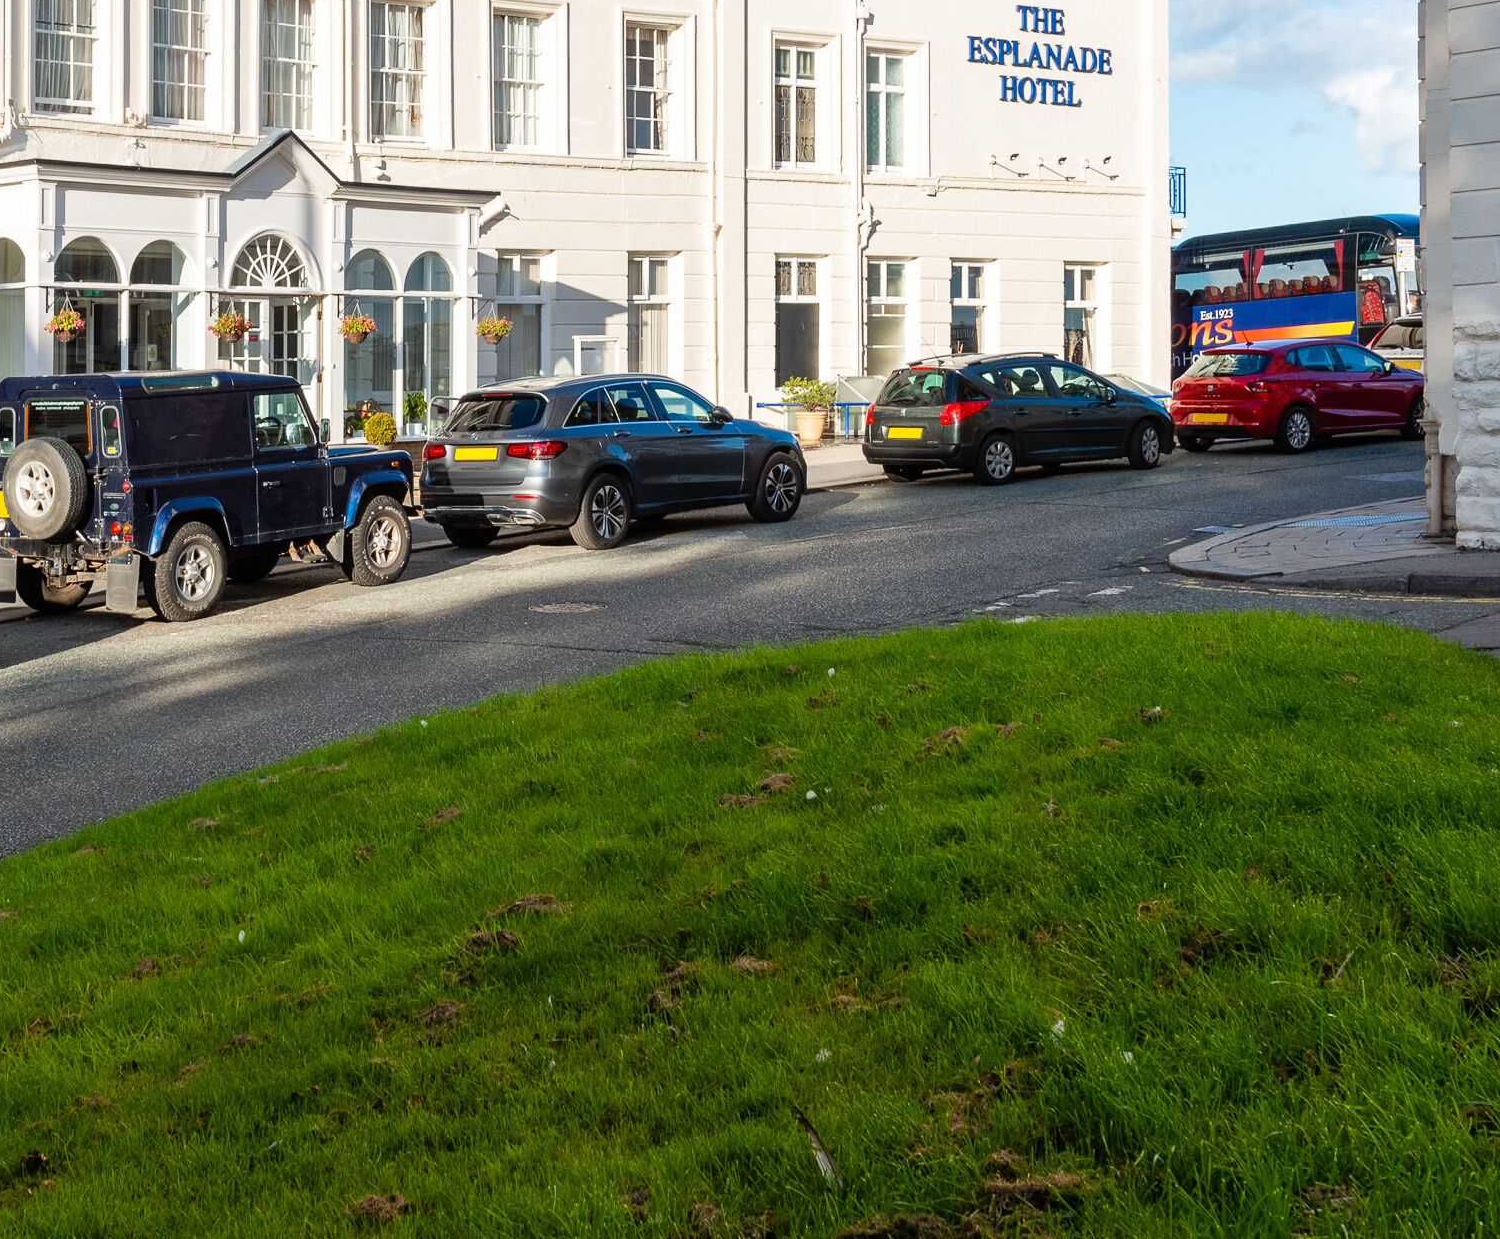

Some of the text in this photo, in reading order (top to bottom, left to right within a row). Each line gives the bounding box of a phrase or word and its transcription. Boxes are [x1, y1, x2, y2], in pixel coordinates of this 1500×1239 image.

[1016, 4, 1065, 36] THE
[967, 35, 1113, 75] ESPLANADE
[999, 75, 1083, 108] HOTEL
[1200, 308, 1234, 321] Est.1923
